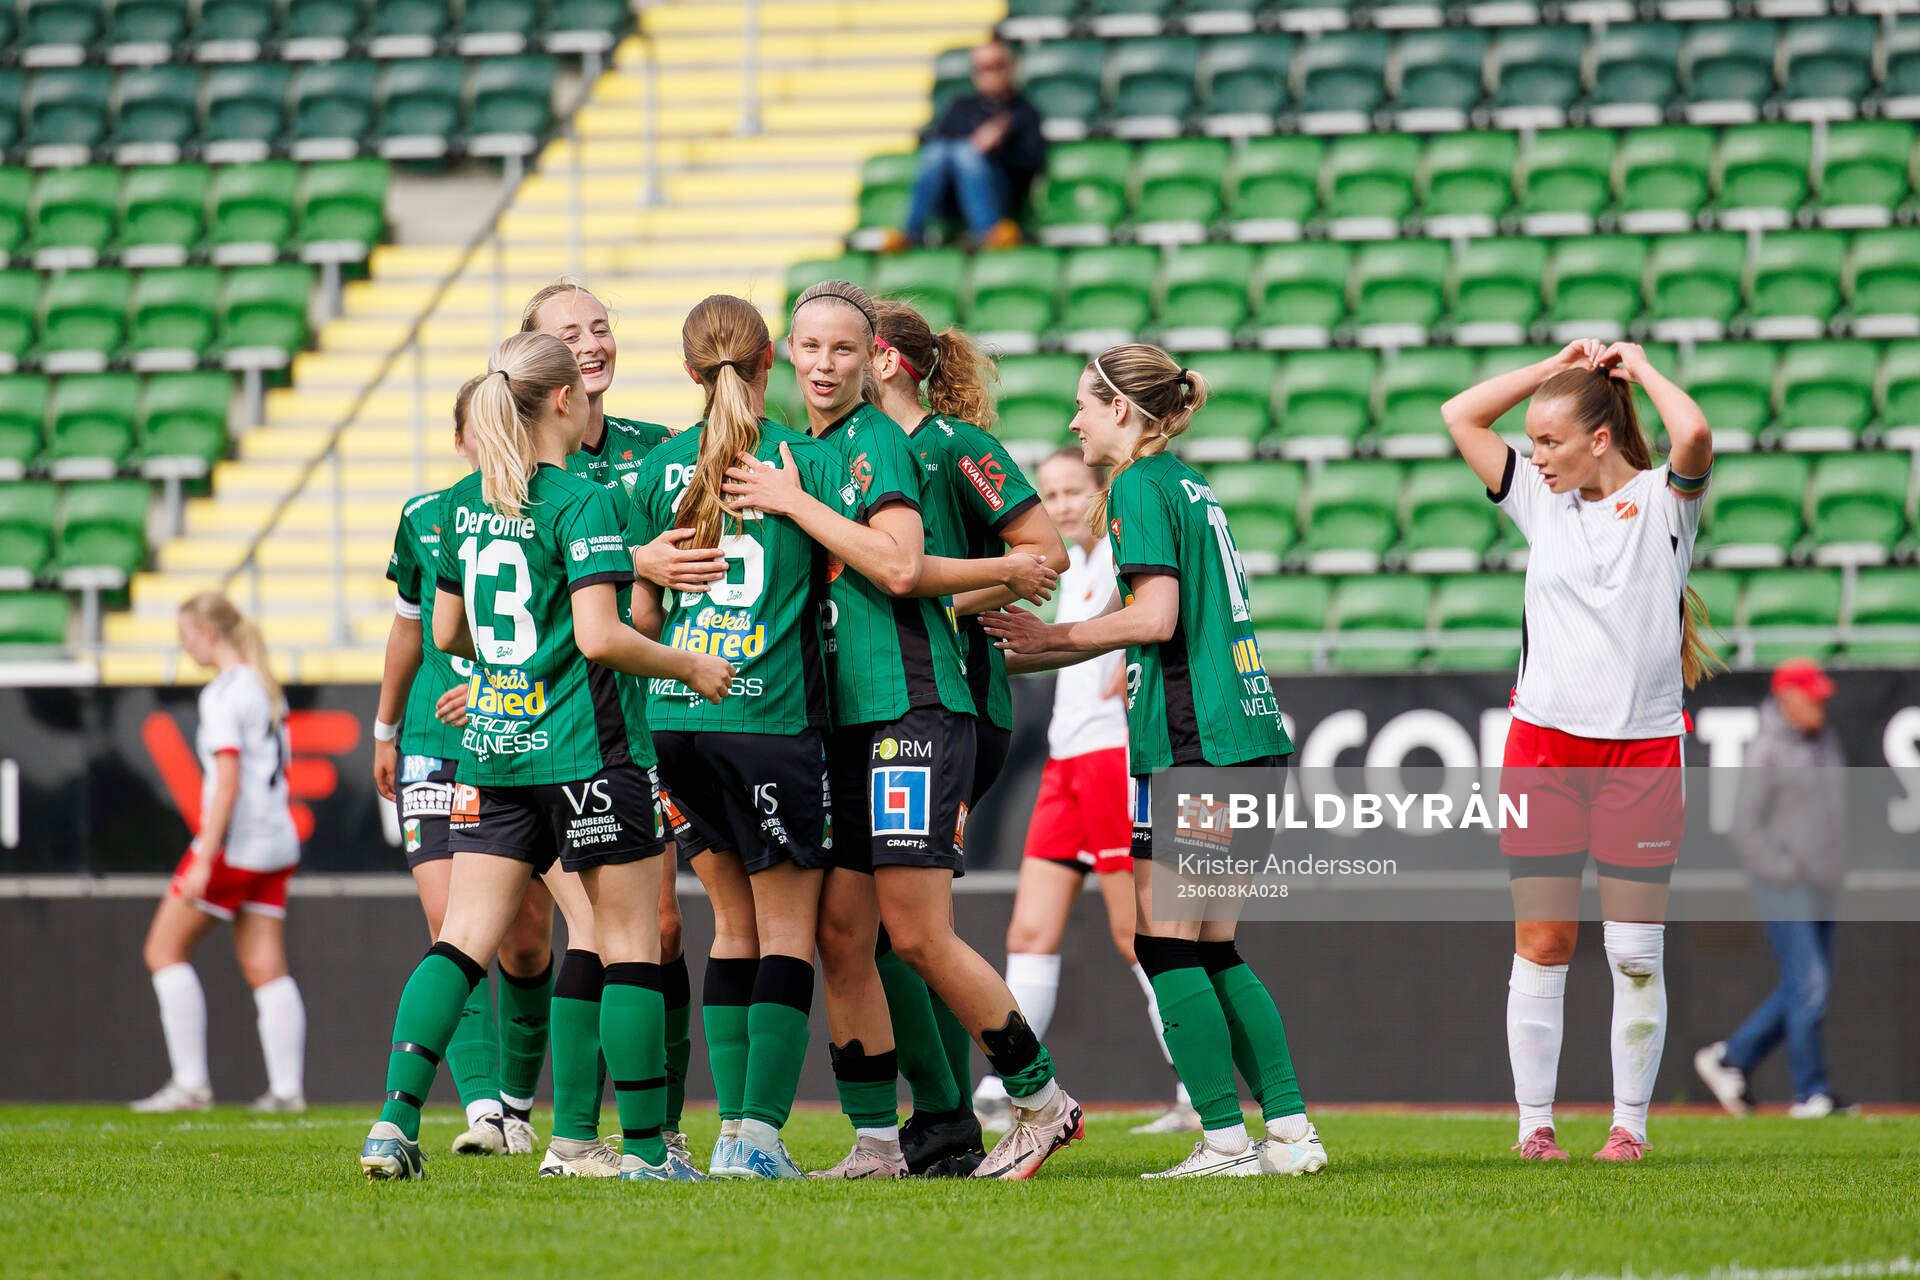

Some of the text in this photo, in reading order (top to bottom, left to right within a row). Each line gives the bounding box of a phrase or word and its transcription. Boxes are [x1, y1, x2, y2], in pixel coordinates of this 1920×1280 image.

[962, 459, 1001, 507] KVANTUM
[977, 452, 1007, 492] ICA
[455, 506, 536, 539] Derome
[591, 544, 623, 553] KOMMUN
[457, 536, 538, 666] 13
[697, 607, 752, 631] Gekås
[562, 779, 612, 815] VS
[566, 823, 623, 839] STADSHOTELL
[571, 814, 615, 829] VARBERGS
[572, 833, 618, 848] & ASIA SPA
[887, 839, 919, 847] CRAFT
